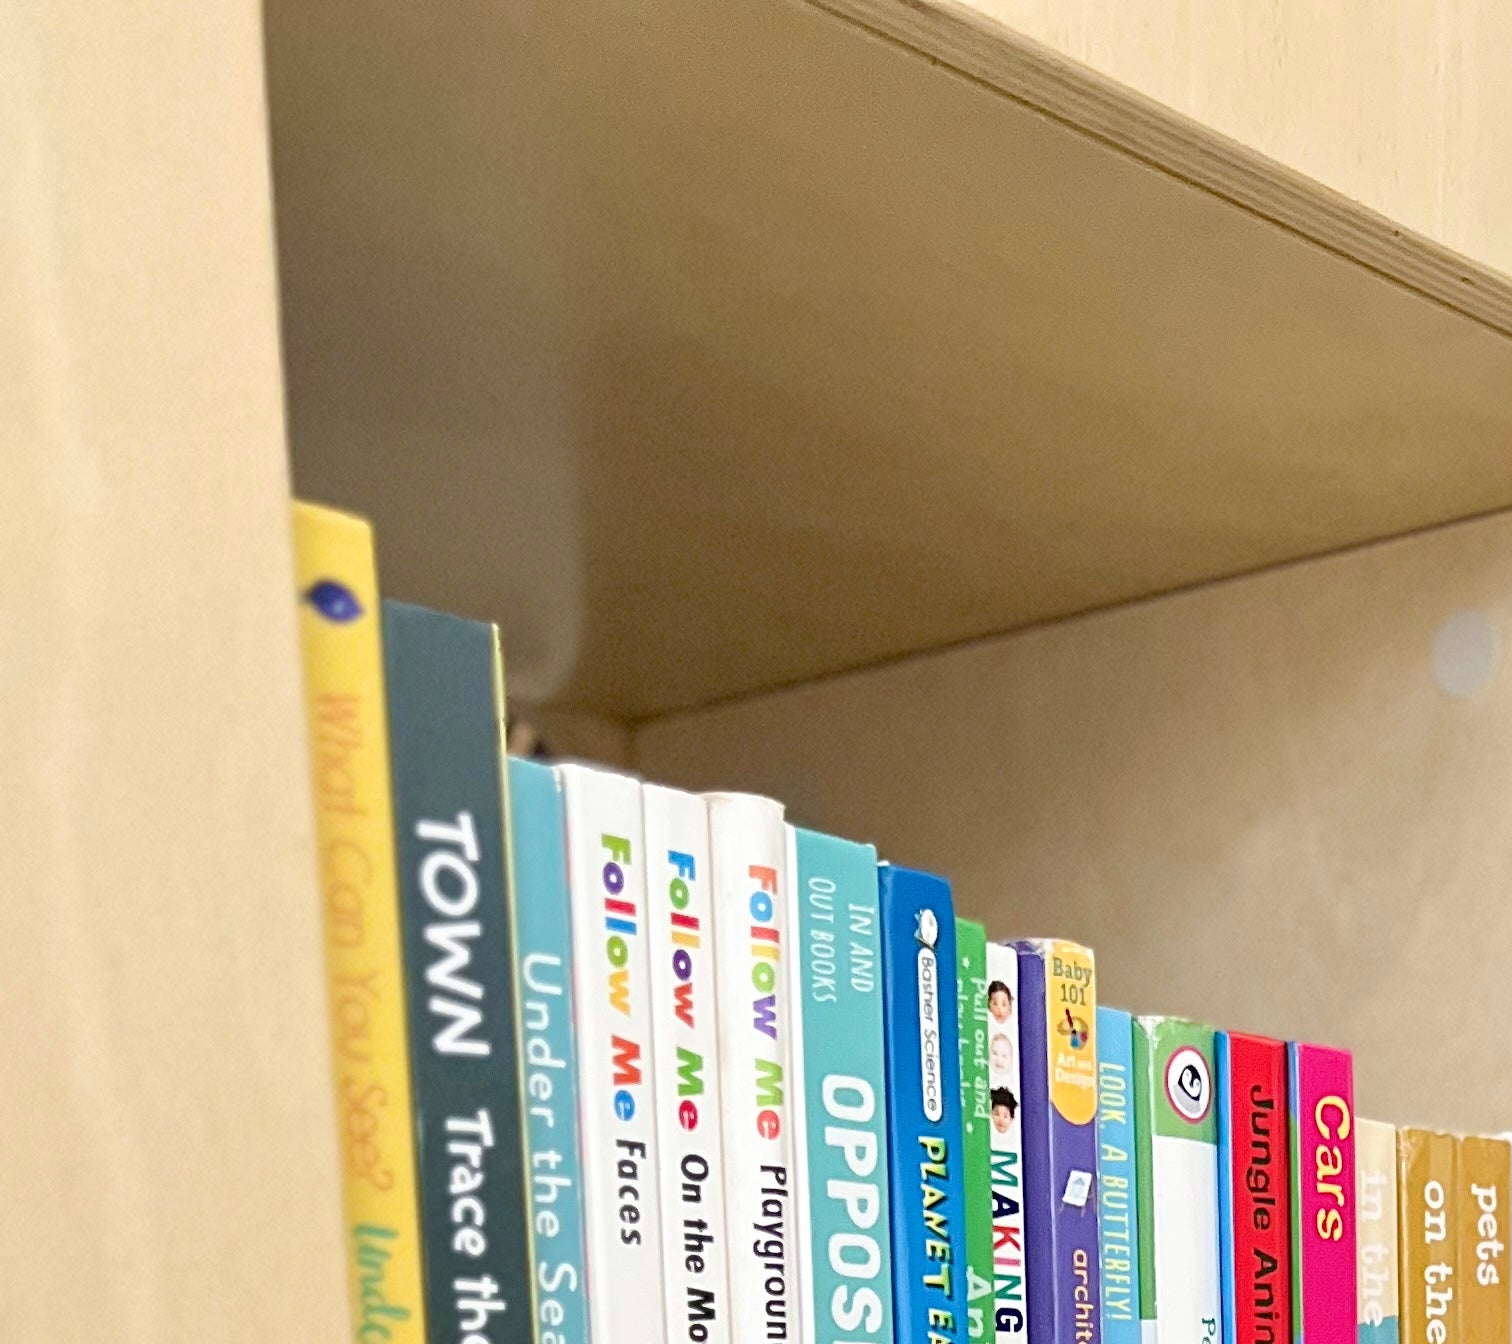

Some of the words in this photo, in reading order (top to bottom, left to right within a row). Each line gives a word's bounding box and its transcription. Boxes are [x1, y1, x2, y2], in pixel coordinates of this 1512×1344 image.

[313, 694, 364, 818] What
[322, 843, 366, 948] Can
[415, 811, 490, 1057] TOWN
[600, 832, 638, 1018] Follow
[667, 850, 701, 1030] Follow
[808, 877, 836, 921] OUT
[847, 903, 875, 938] IN
[748, 864, 787, 1041] Follow
[810, 928, 837, 1003] BOOKS
[849, 942, 875, 993] AND
[921, 956, 936, 1022] Basher
[1053, 957, 1092, 988] Baby
[1060, 984, 1086, 1006] 101
[330, 965, 386, 1068] You
[522, 952, 554, 1129] Under
[611, 1034, 642, 1122] Me
[676, 1047, 705, 1131] Me
[755, 1057, 785, 1141] Me
[924, 1024, 938, 1113] Science
[1098, 1061, 1126, 1130] LOOK,
[342, 1084, 395, 1192] See?
[681, 1153, 710, 1205] On
[1101, 1142, 1128, 1162] A
[1246, 1084, 1277, 1231] Jungle
[1314, 1095, 1351, 1242] Cars
[445, 1109, 494, 1258] Trace
[532, 1150, 571, 1239] the
[614, 1138, 647, 1247] Faces
[917, 1134, 953, 1299] PLANET
[1361, 1170, 1387, 1223] in
[1424, 1180, 1447, 1244] on
[682, 1217, 714, 1273] the
[990, 1150, 1024, 1333] MAKING
[1101, 1174, 1132, 1321] BUTTERFLY!
[1471, 1183, 1504, 1286] pets
[1361, 1244, 1389, 1328] the
